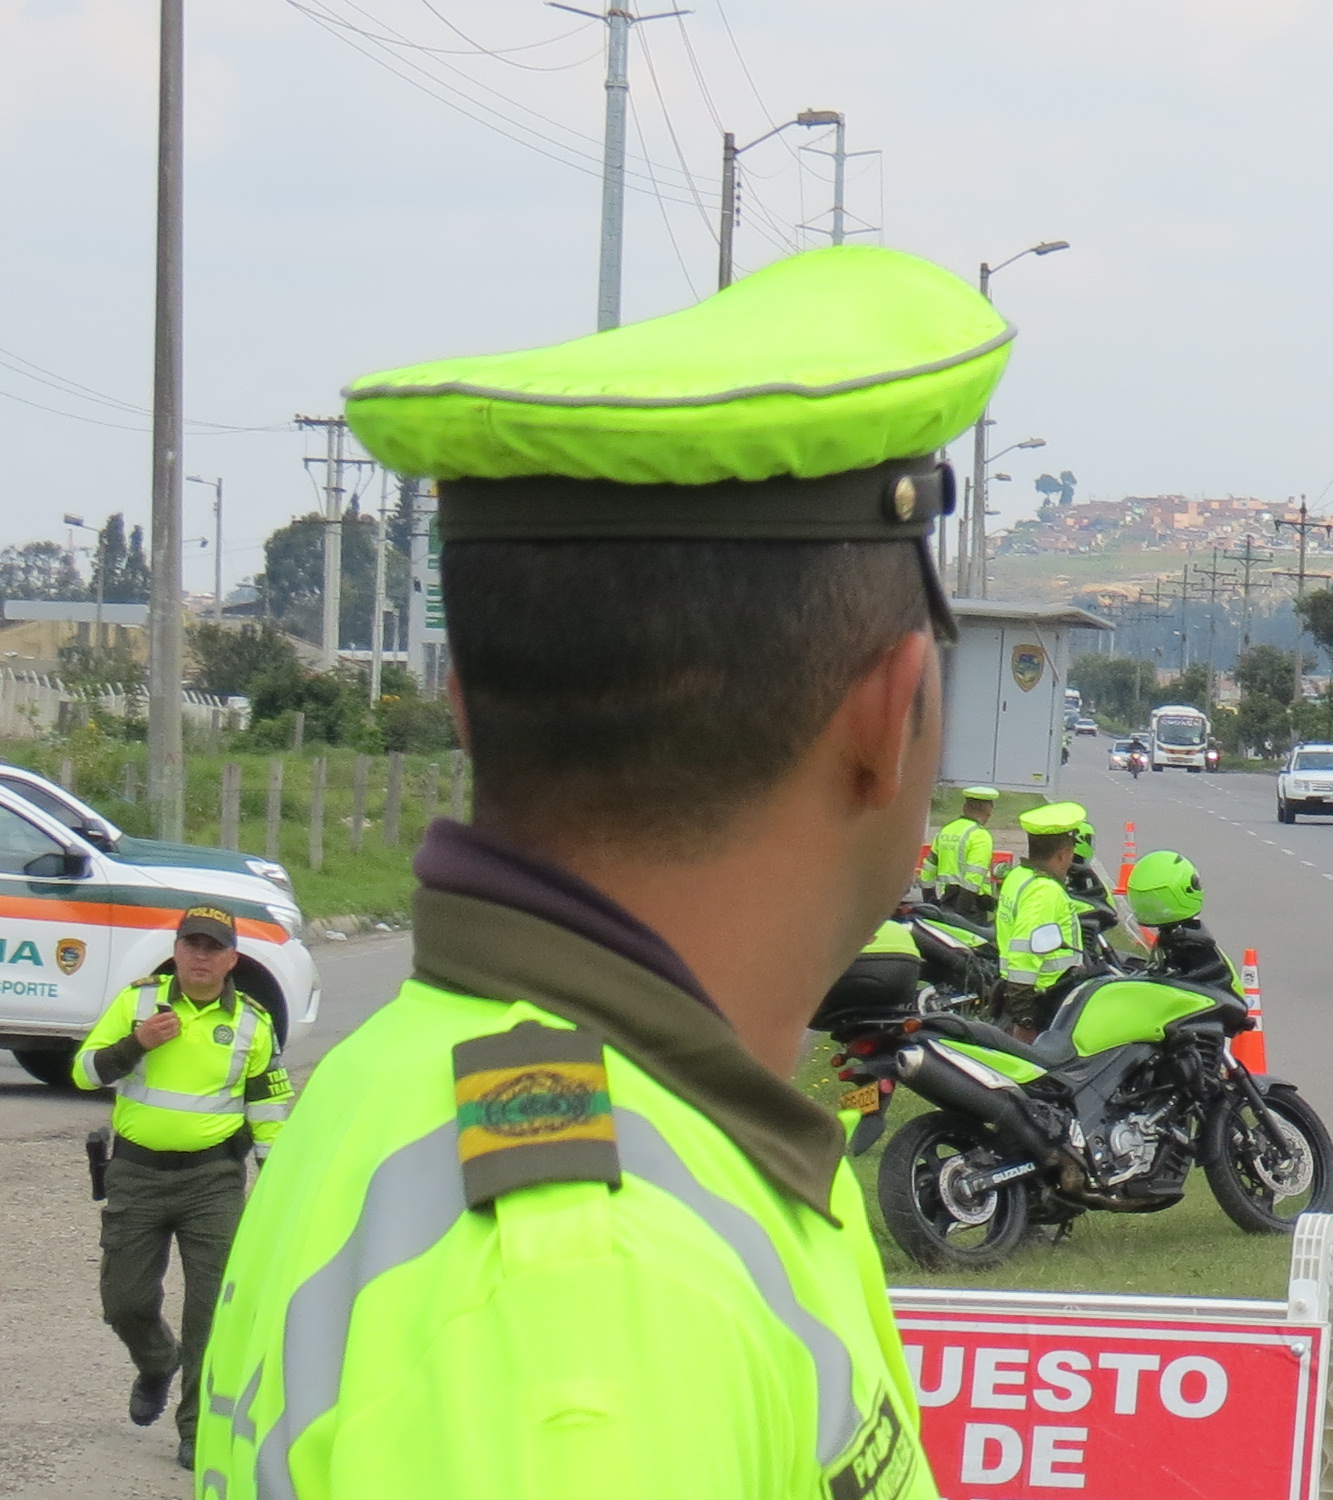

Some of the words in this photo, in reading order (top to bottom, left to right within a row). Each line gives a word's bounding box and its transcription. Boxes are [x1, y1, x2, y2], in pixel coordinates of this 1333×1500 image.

[0, 938, 44, 967] IA
[0, 980, 58, 998] PORTE
[902, 1345, 1228, 1419] UESTO
[960, 1422, 1088, 1489] DE
